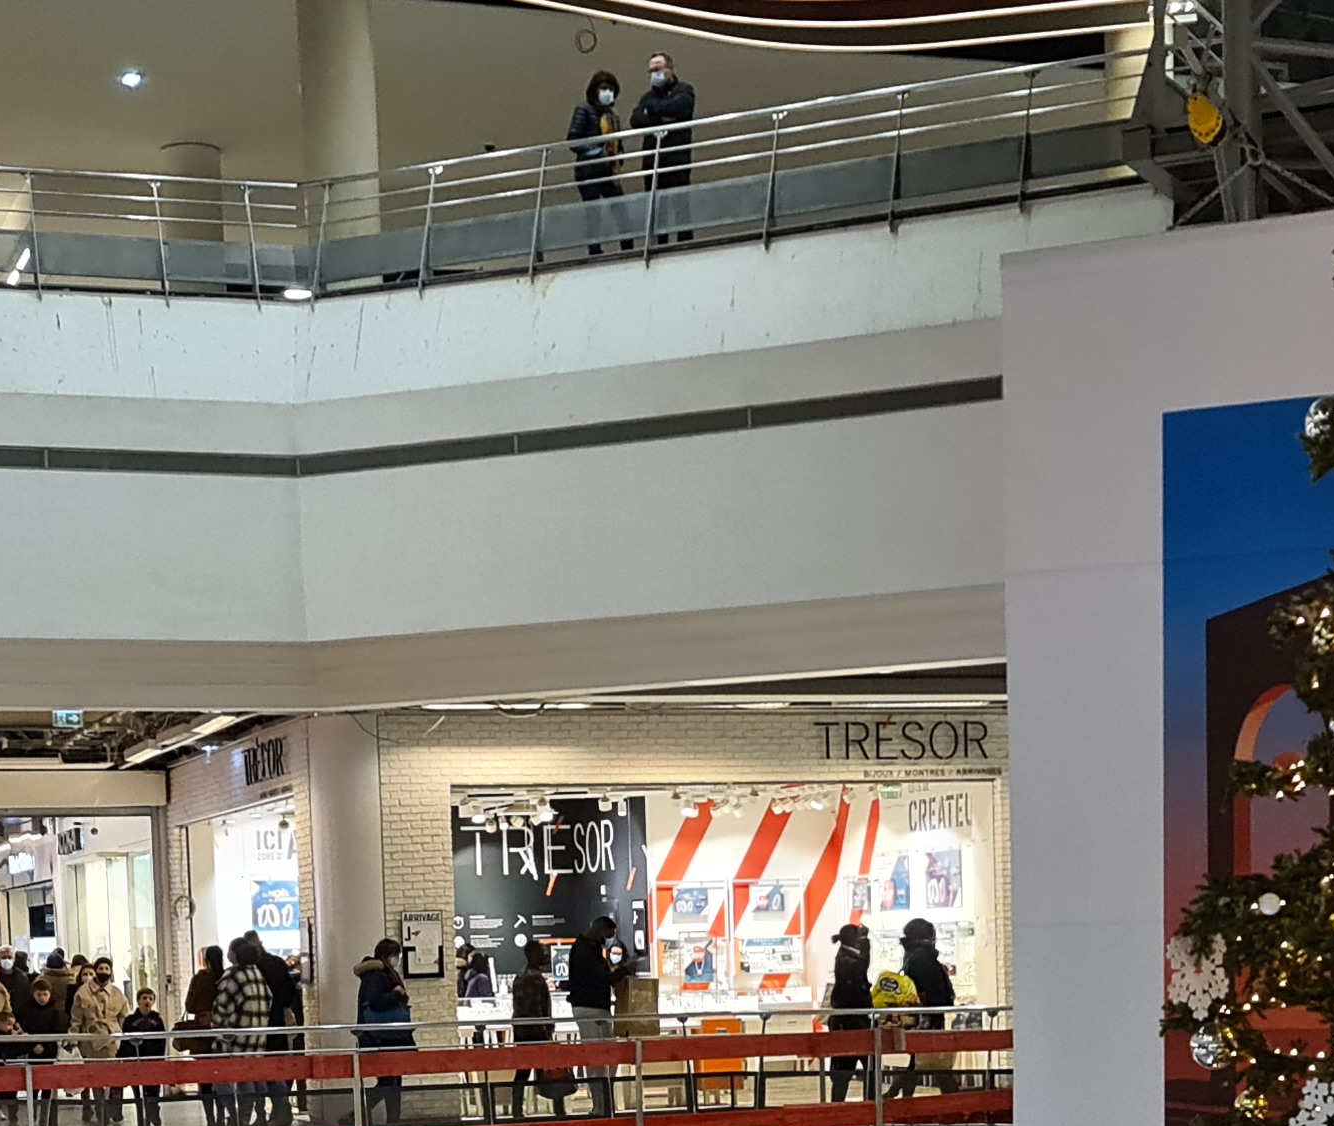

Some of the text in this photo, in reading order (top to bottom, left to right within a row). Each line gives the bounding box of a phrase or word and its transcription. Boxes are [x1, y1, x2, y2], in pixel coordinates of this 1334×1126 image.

[863, 769, 894, 779] BIJOUX
[904, 768, 946, 778] MONTRES
[908, 792, 973, 833] CREATEU
[256, 829, 297, 860] ICI A
